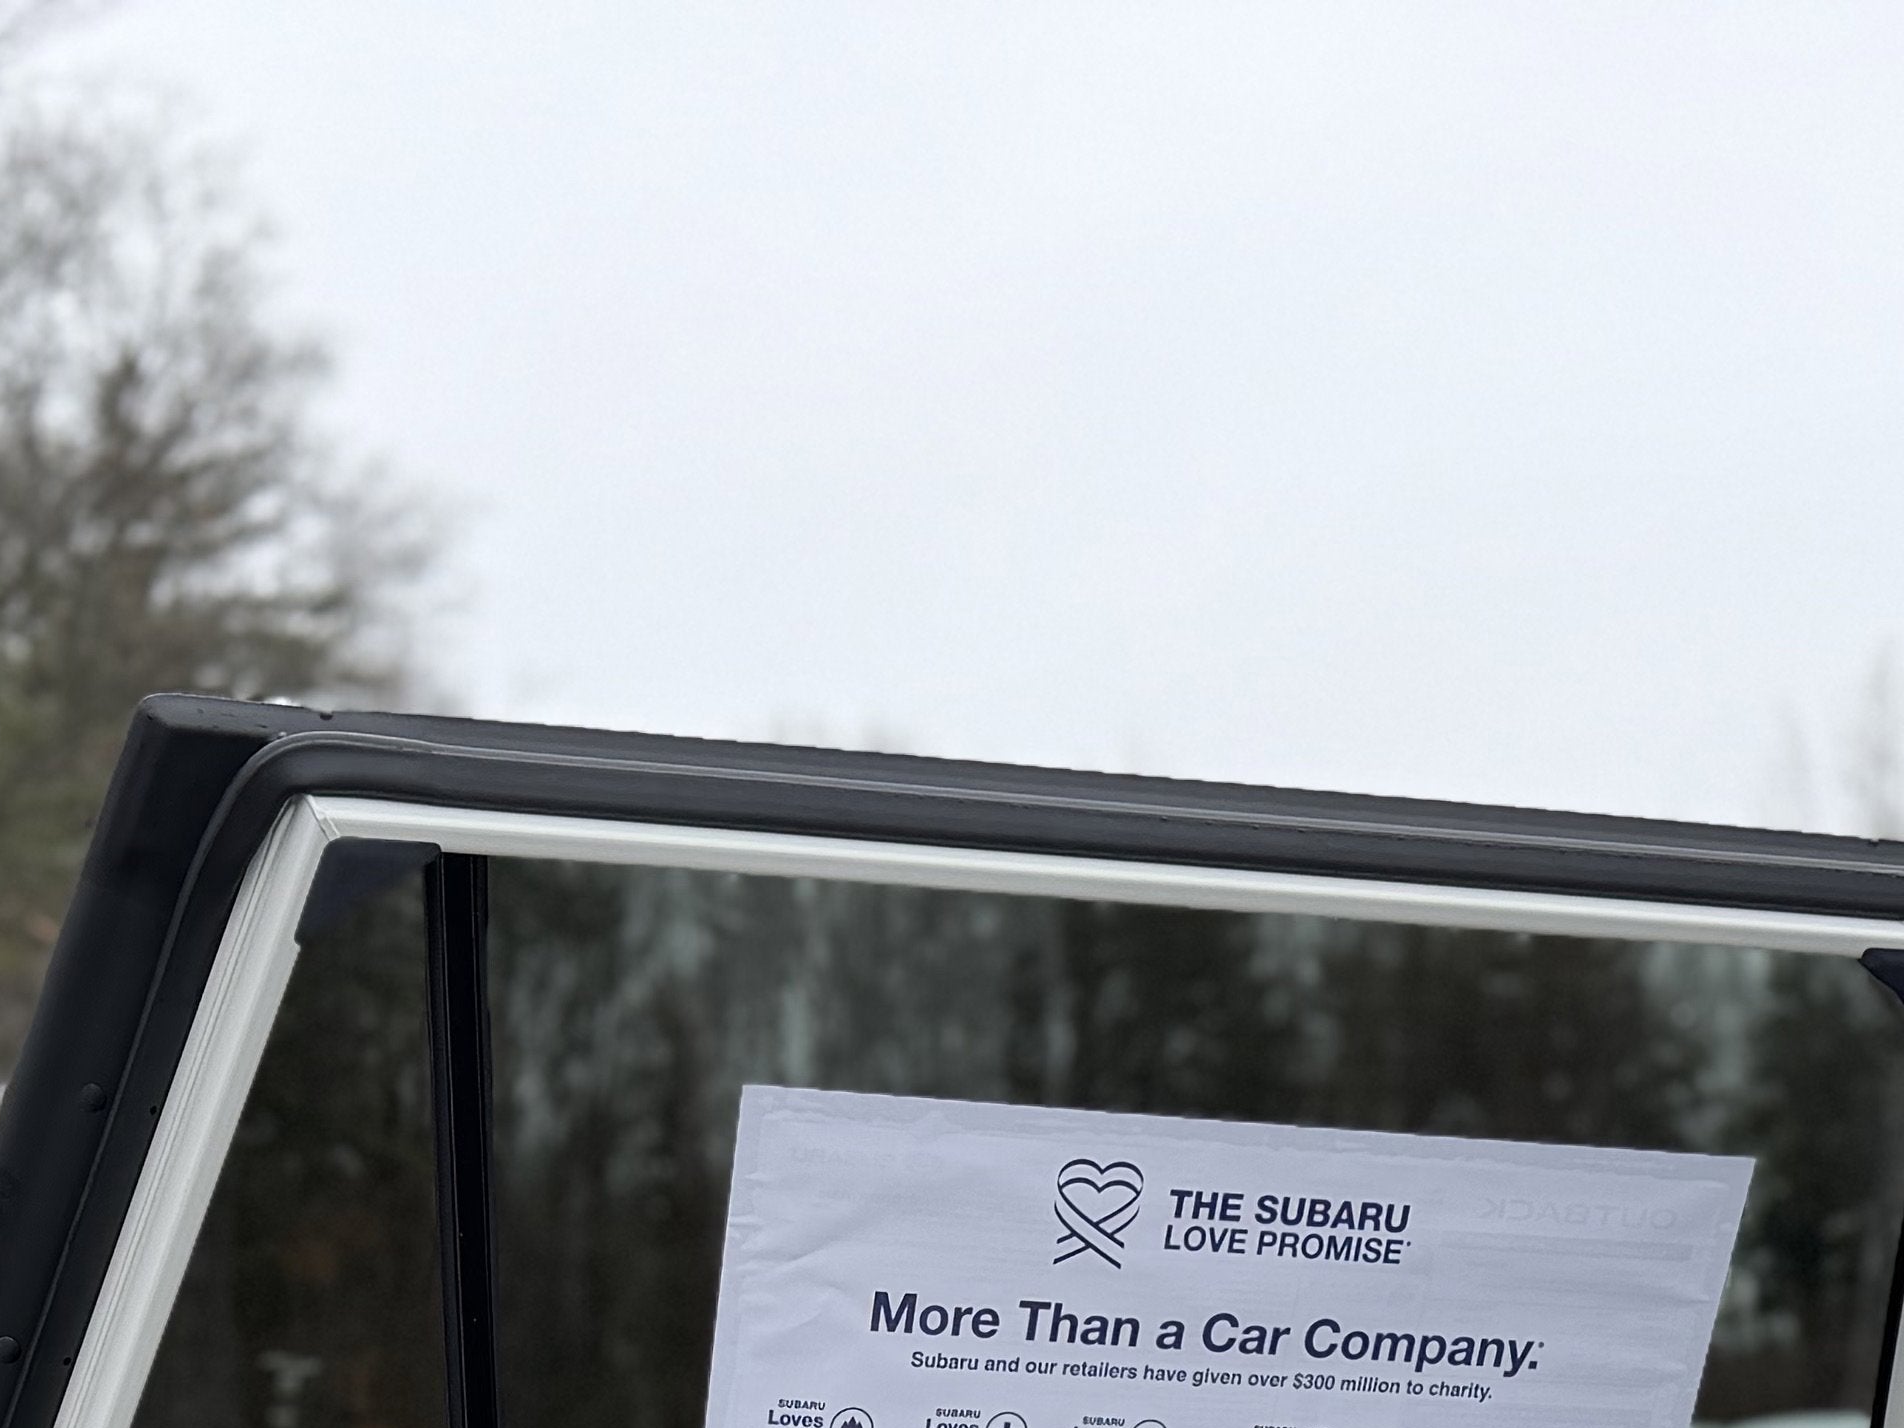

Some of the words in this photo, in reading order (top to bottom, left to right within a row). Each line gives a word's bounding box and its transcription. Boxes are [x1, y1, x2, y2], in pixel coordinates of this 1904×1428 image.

[1169, 1189, 1245, 1223] THE
[1254, 1194, 1411, 1234] SUBARU
[1163, 1224, 1249, 1255] LOVE
[1256, 1230, 1404, 1265] PROMISE
[870, 1290, 1000, 1339] More
[1018, 1300, 1140, 1348] Than
[1155, 1320, 1185, 1350] a
[1202, 1312, 1292, 1356] Car
[910, 1351, 980, 1371] Subaru
[984, 1356, 1021, 1373] and
[1025, 1361, 1058, 1375] our
[1062, 1361, 1138, 1380] retailers
[1143, 1364, 1187, 1383] have
[1192, 1367, 1242, 1388] given
[1247, 1373, 1289, 1388] over
[1292, 1372, 1336, 1391] $300
[1340, 1375, 1401, 1394] million
[1406, 1379, 1424, 1396] to
[1428, 1381, 1492, 1403] charity.
[767, 1409, 823, 1428] Loves
[777, 1398, 825, 1411] SUBARU
[935, 1408, 981, 1419] SUBARU
[1082, 1416, 1126, 1427] SUBARU
